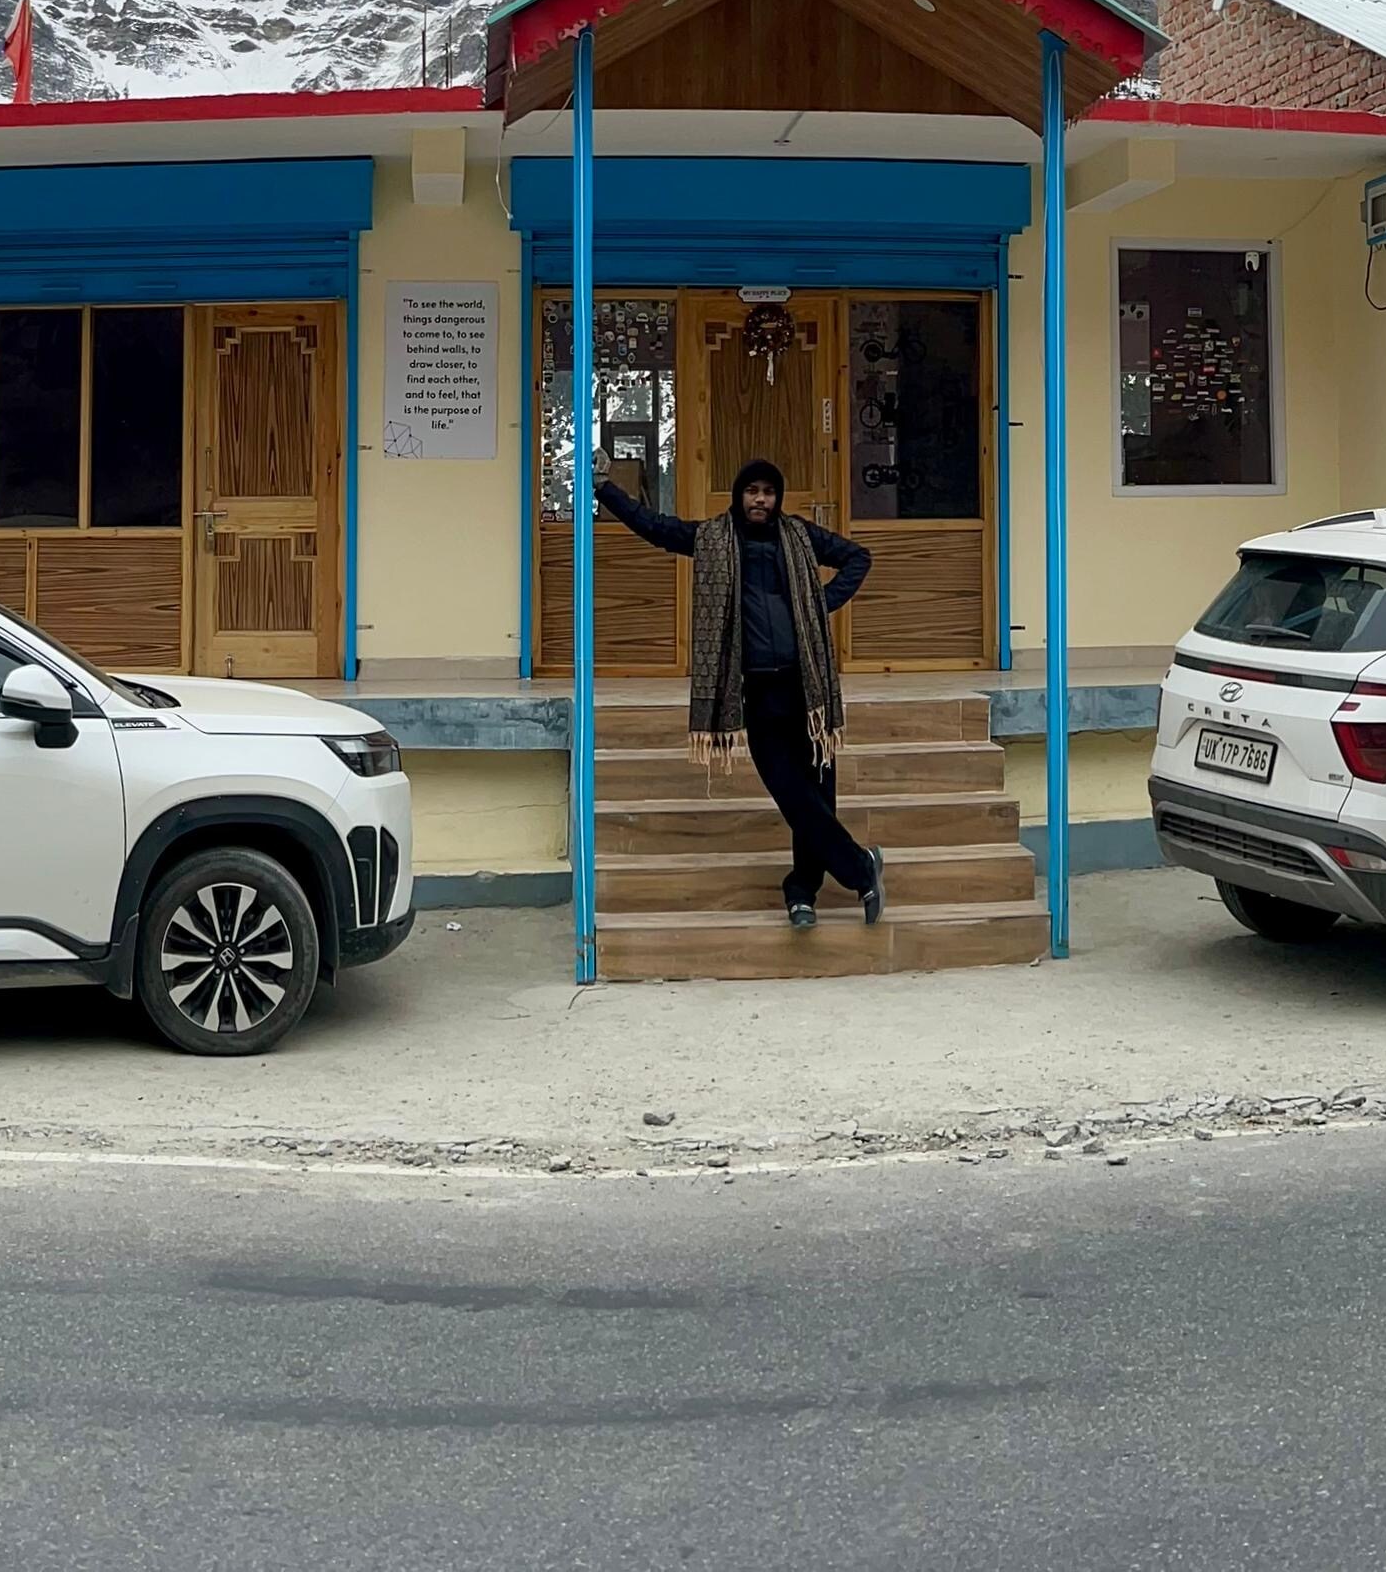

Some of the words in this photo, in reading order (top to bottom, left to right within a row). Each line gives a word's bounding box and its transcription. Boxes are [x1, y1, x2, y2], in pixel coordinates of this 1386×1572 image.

[439, 300, 454, 308] the
[456, 300, 485, 309] world,
[403, 315, 432, 325] things
[434, 315, 485, 326] dangerous
[403, 330, 412, 338] to
[443, 330, 454, 339] to,
[457, 330, 466, 338] to
[407, 344, 439, 353] behind
[442, 345, 468, 354] walls,
[410, 359, 433, 368] draw
[436, 359, 465, 370] closer,
[468, 360, 477, 368] to
[407, 374, 425, 383] find
[428, 375, 450, 383] each
[453, 375, 480, 385] other,
[405, 390, 424, 399] and
[427, 391, 436, 399] to
[439, 390, 458, 400] feel,
[461, 390, 480, 399] that
[404, 405, 411, 414] is
[414, 406, 429, 414] the
[432, 408, 469, 416] purpose
[472, 405, 482, 414] of
[1187, 703, 1272, 728] CRETA
[1204, 738, 1219, 761] UK
[1220, 742, 1239, 765] 17P
[1239, 746, 1268, 771] 7686
